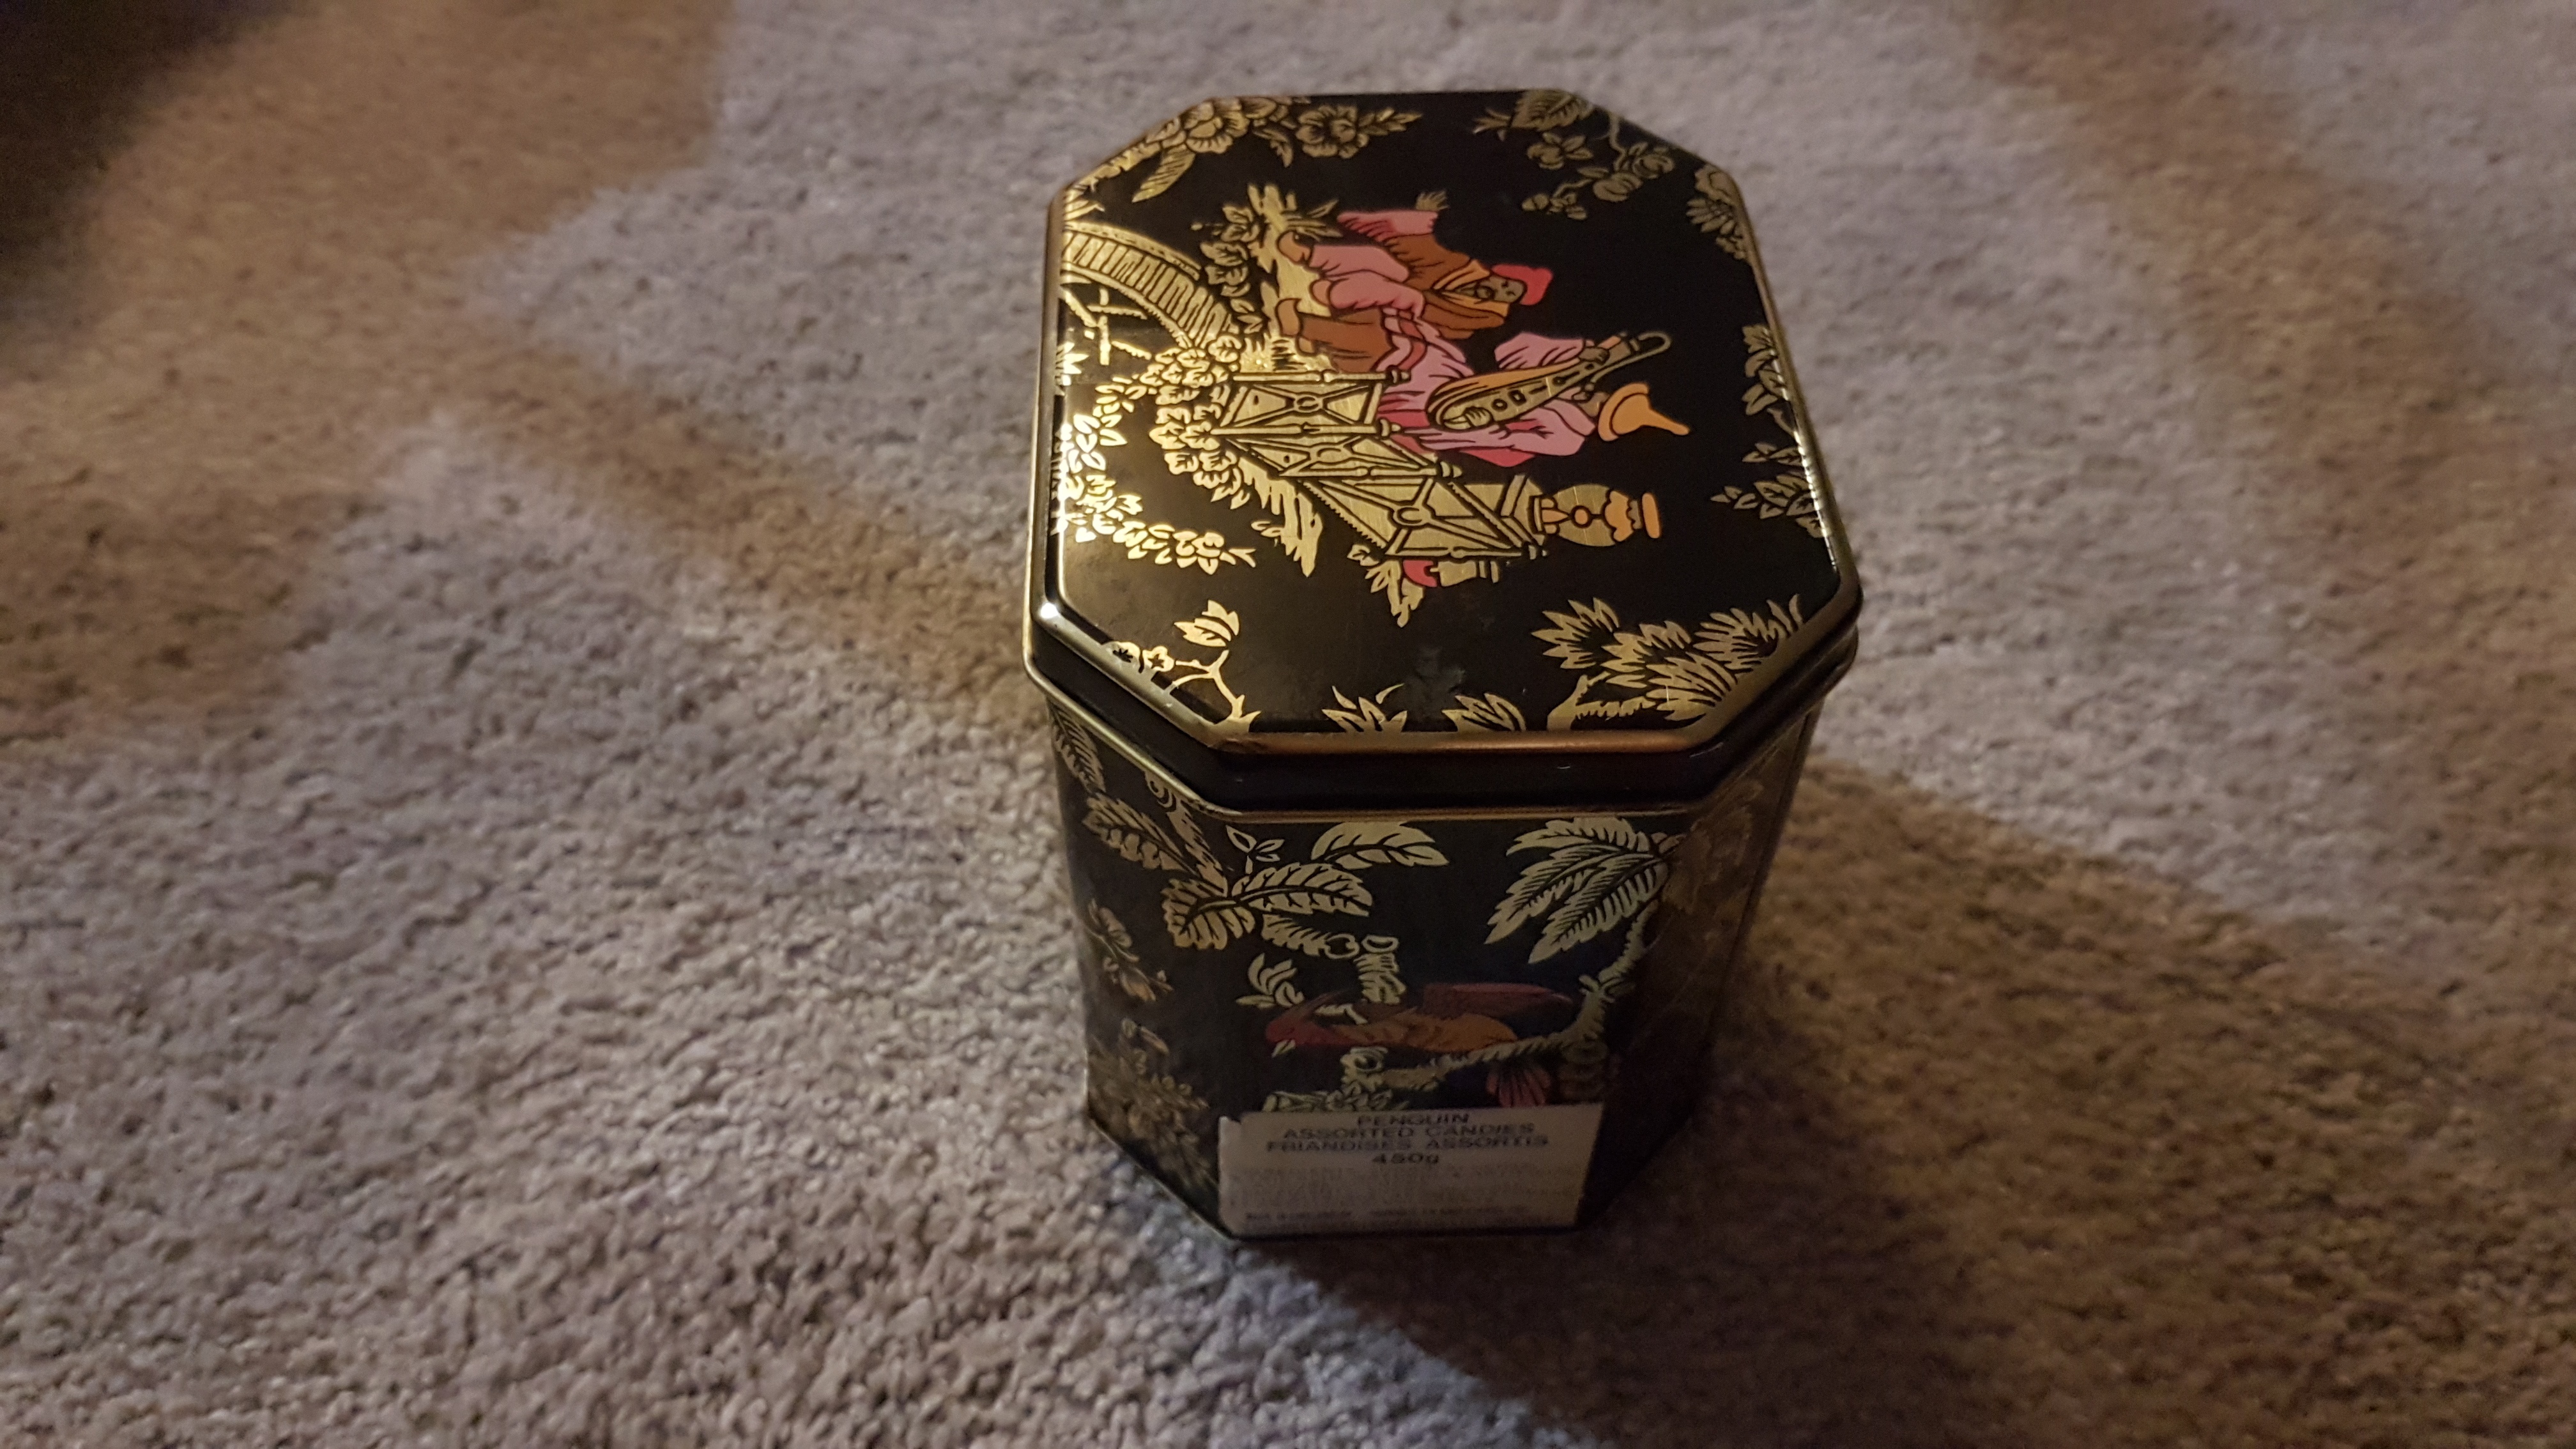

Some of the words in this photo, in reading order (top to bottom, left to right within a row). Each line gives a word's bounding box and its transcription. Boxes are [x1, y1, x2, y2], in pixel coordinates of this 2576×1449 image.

[1356, 1114, 1469, 1127] PENGUIN
[1284, 1127, 1415, 1140] ASSORTED
[1425, 1123, 1535, 1137] CANDIES
[1266, 1140, 1412, 1153] FRIANDISES
[1426, 1135, 1549, 1150] ASSORTIS
[1372, 1152, 1439, 1165] 450g
